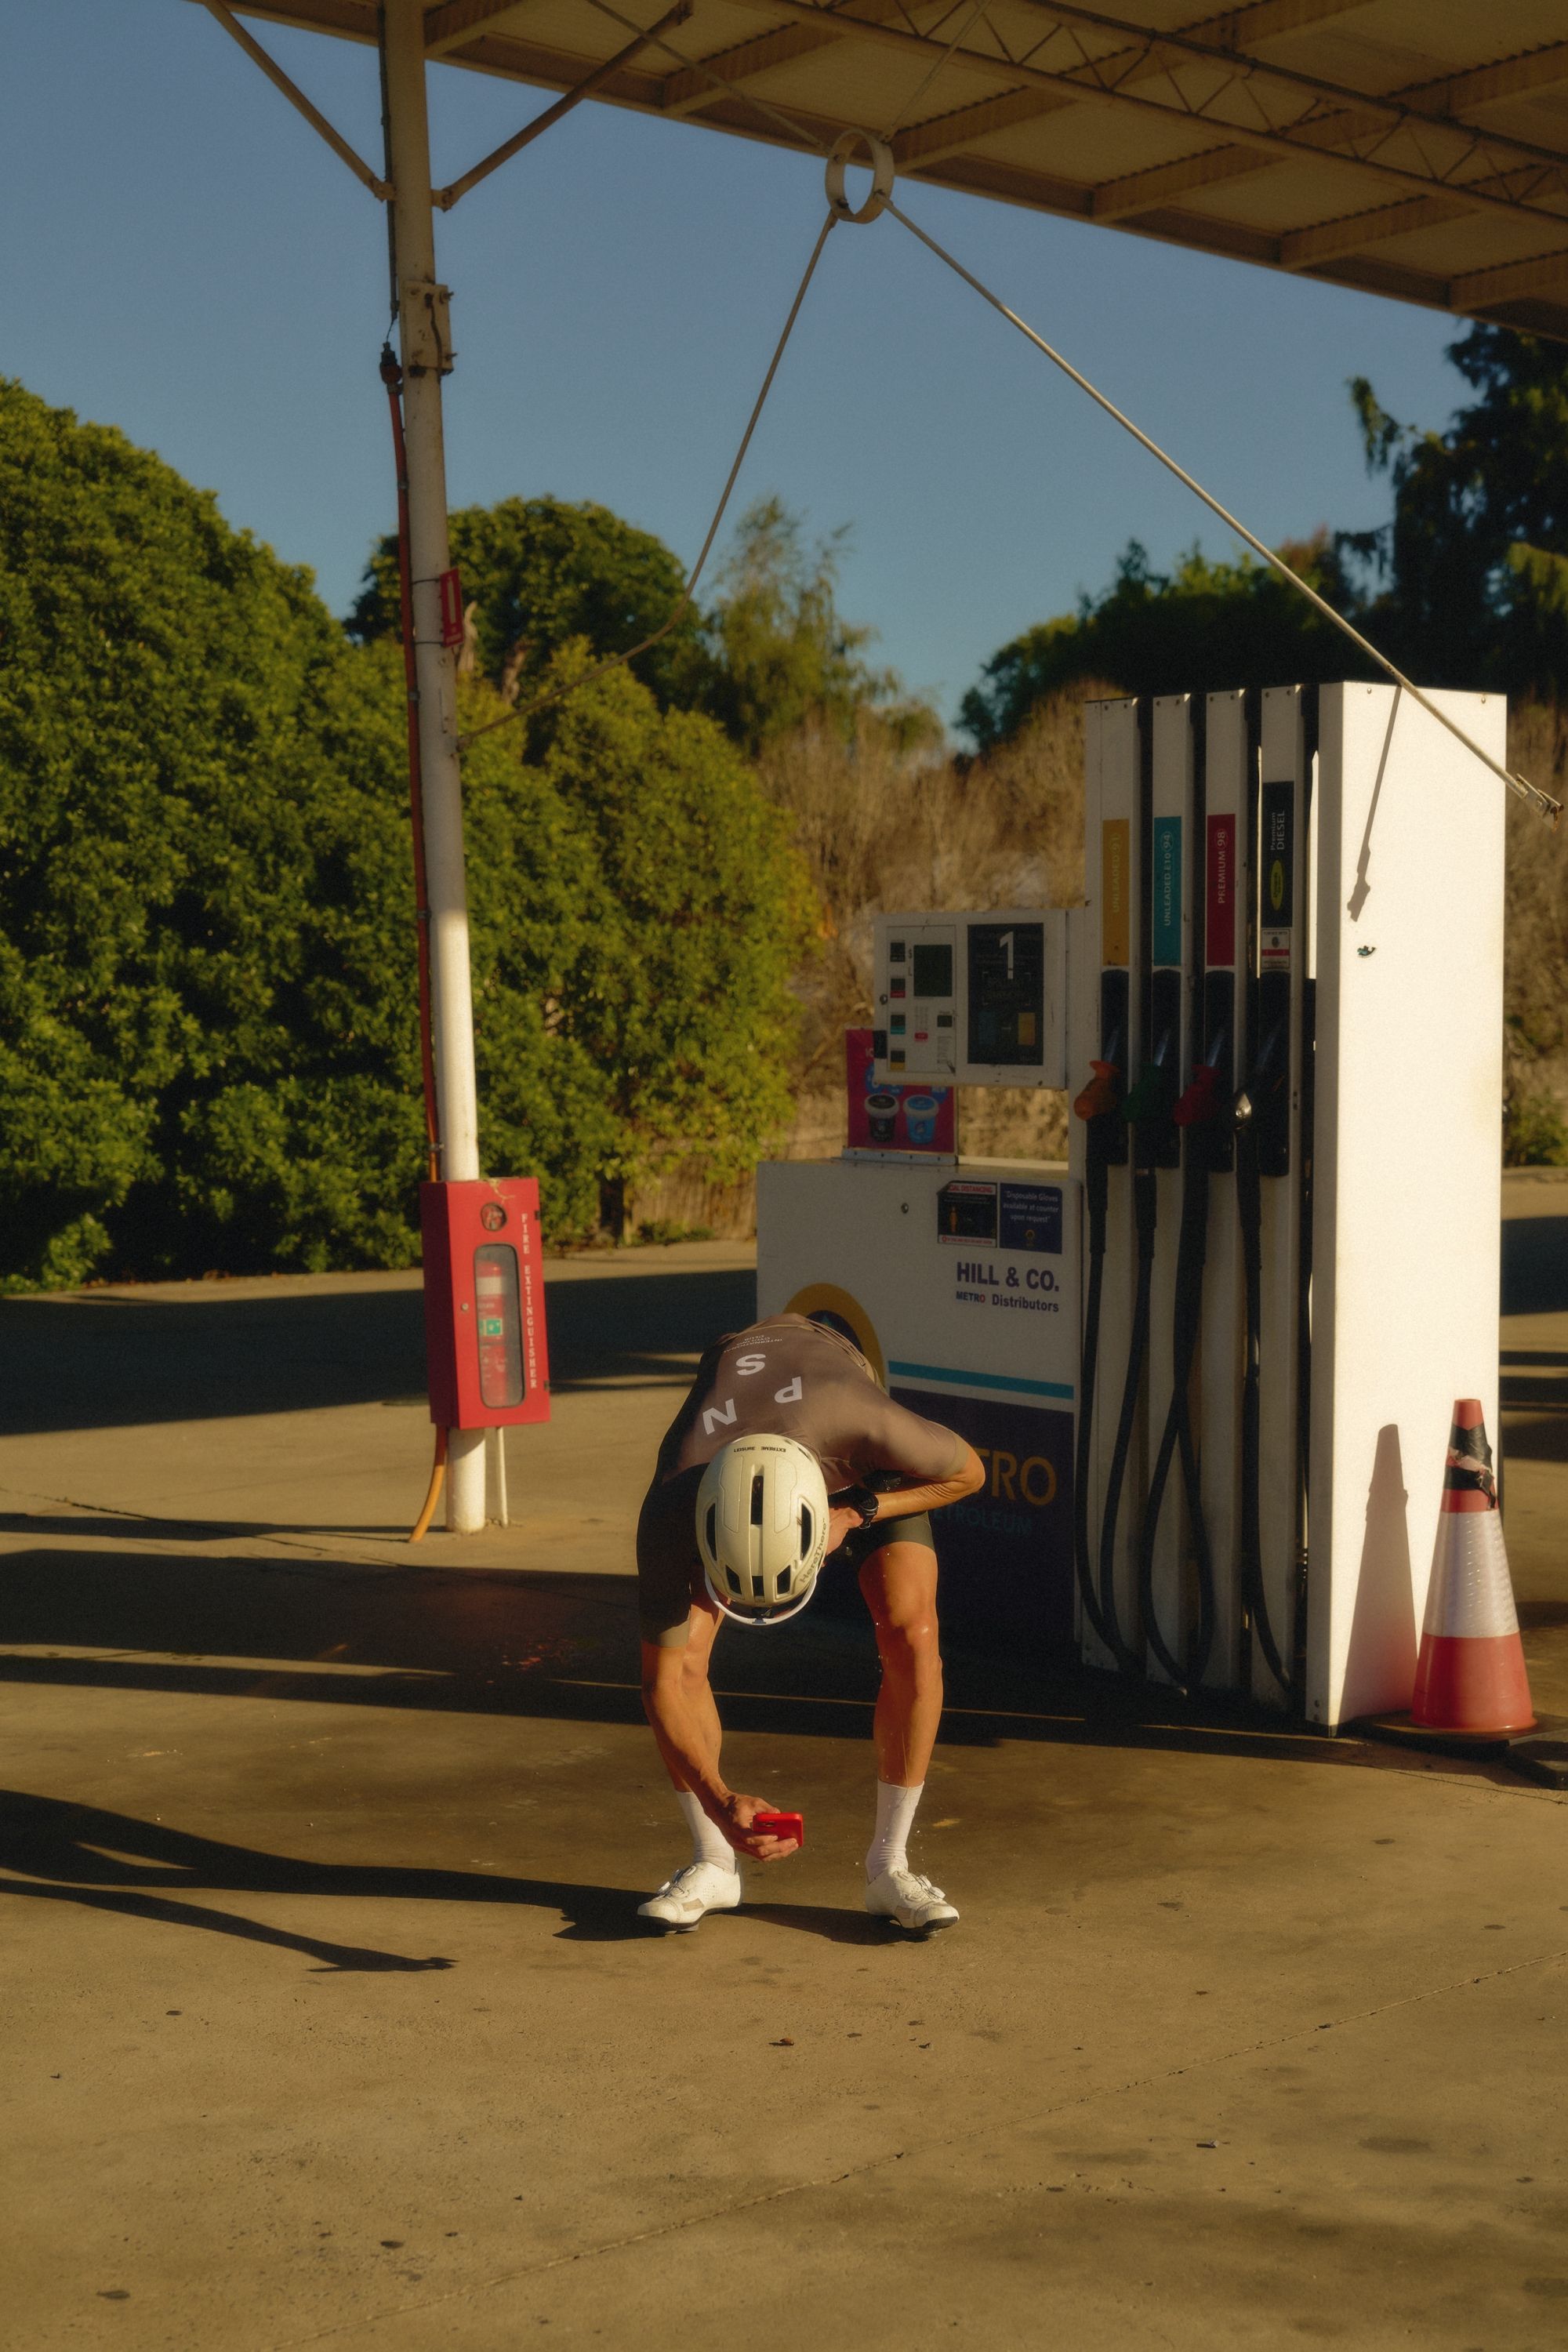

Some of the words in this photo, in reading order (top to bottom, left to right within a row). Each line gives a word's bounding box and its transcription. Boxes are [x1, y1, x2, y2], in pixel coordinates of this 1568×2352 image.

[1163, 834, 1171, 849] 94
[1217, 832, 1225, 847] 98
[1276, 810, 1285, 851] DIESEL
[999, 931, 1014, 979] 1
[1038, 1192, 1058, 1202] Gloves
[956, 1261, 1000, 1286] HILL
[1006, 1266, 1019, 1287] &
[1026, 1269, 1059, 1292] CO.
[956, 1290, 985, 1303] METRO
[992, 1294, 1059, 1312] Distributors
[524, 1265, 537, 1388] EXTINGUISHER
[735, 1353, 767, 1376] S
[774, 1376, 803, 1403] P
[702, 1398, 738, 1436] N
[933, 1504, 1033, 1537] ETROLEUM
